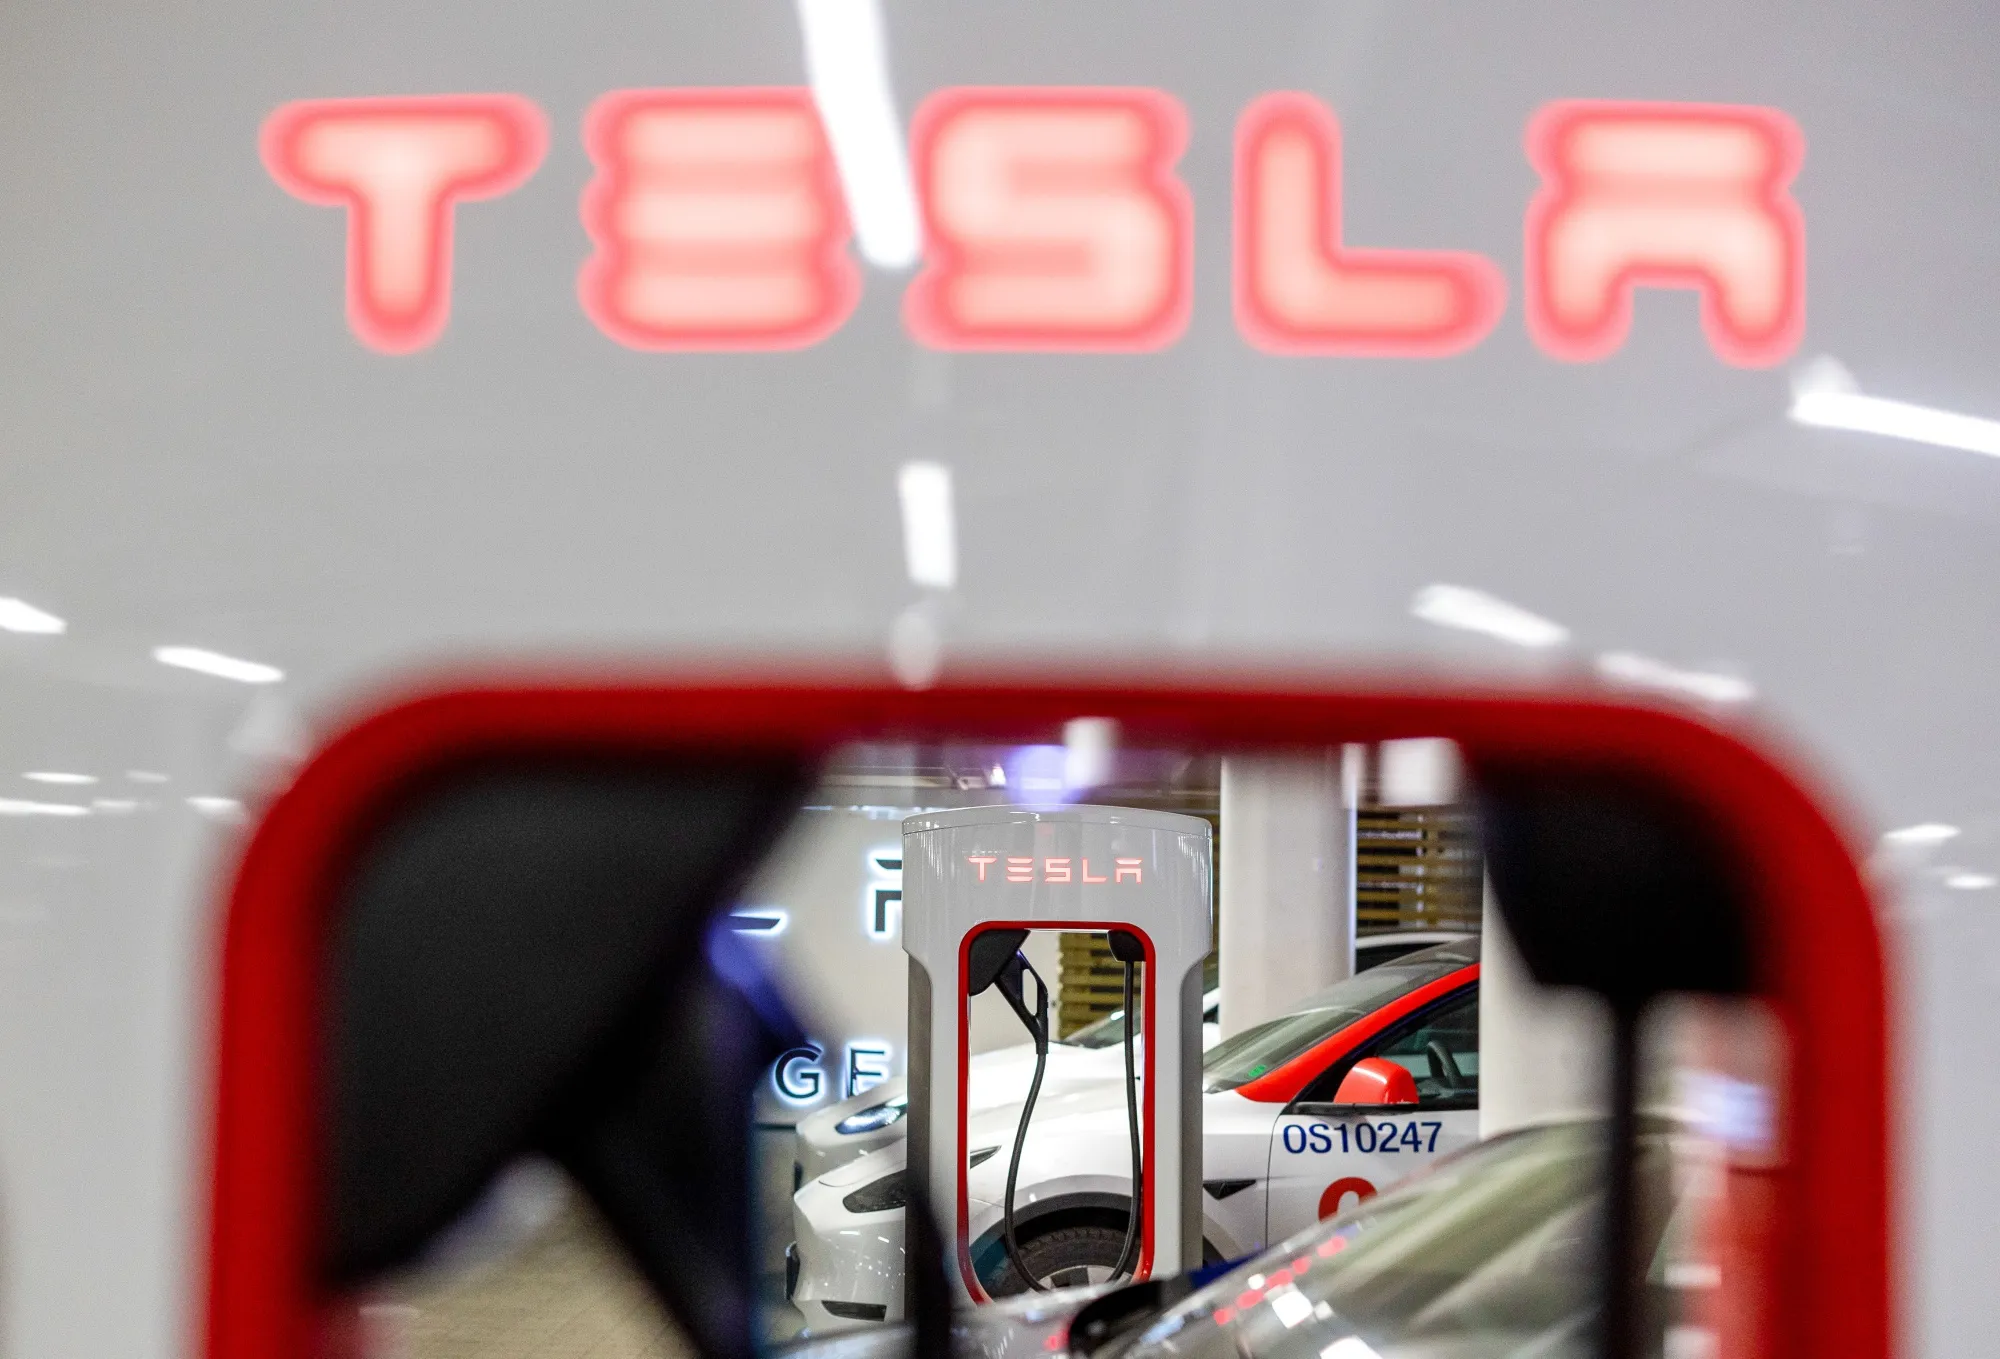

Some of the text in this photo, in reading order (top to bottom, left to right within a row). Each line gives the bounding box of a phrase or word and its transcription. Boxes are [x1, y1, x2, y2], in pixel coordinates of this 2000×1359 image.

[260, 85, 1807, 369] TESLA
[966, 855, 1144, 885] TESLA
[1282, 1121, 1443, 1155] OS10247
